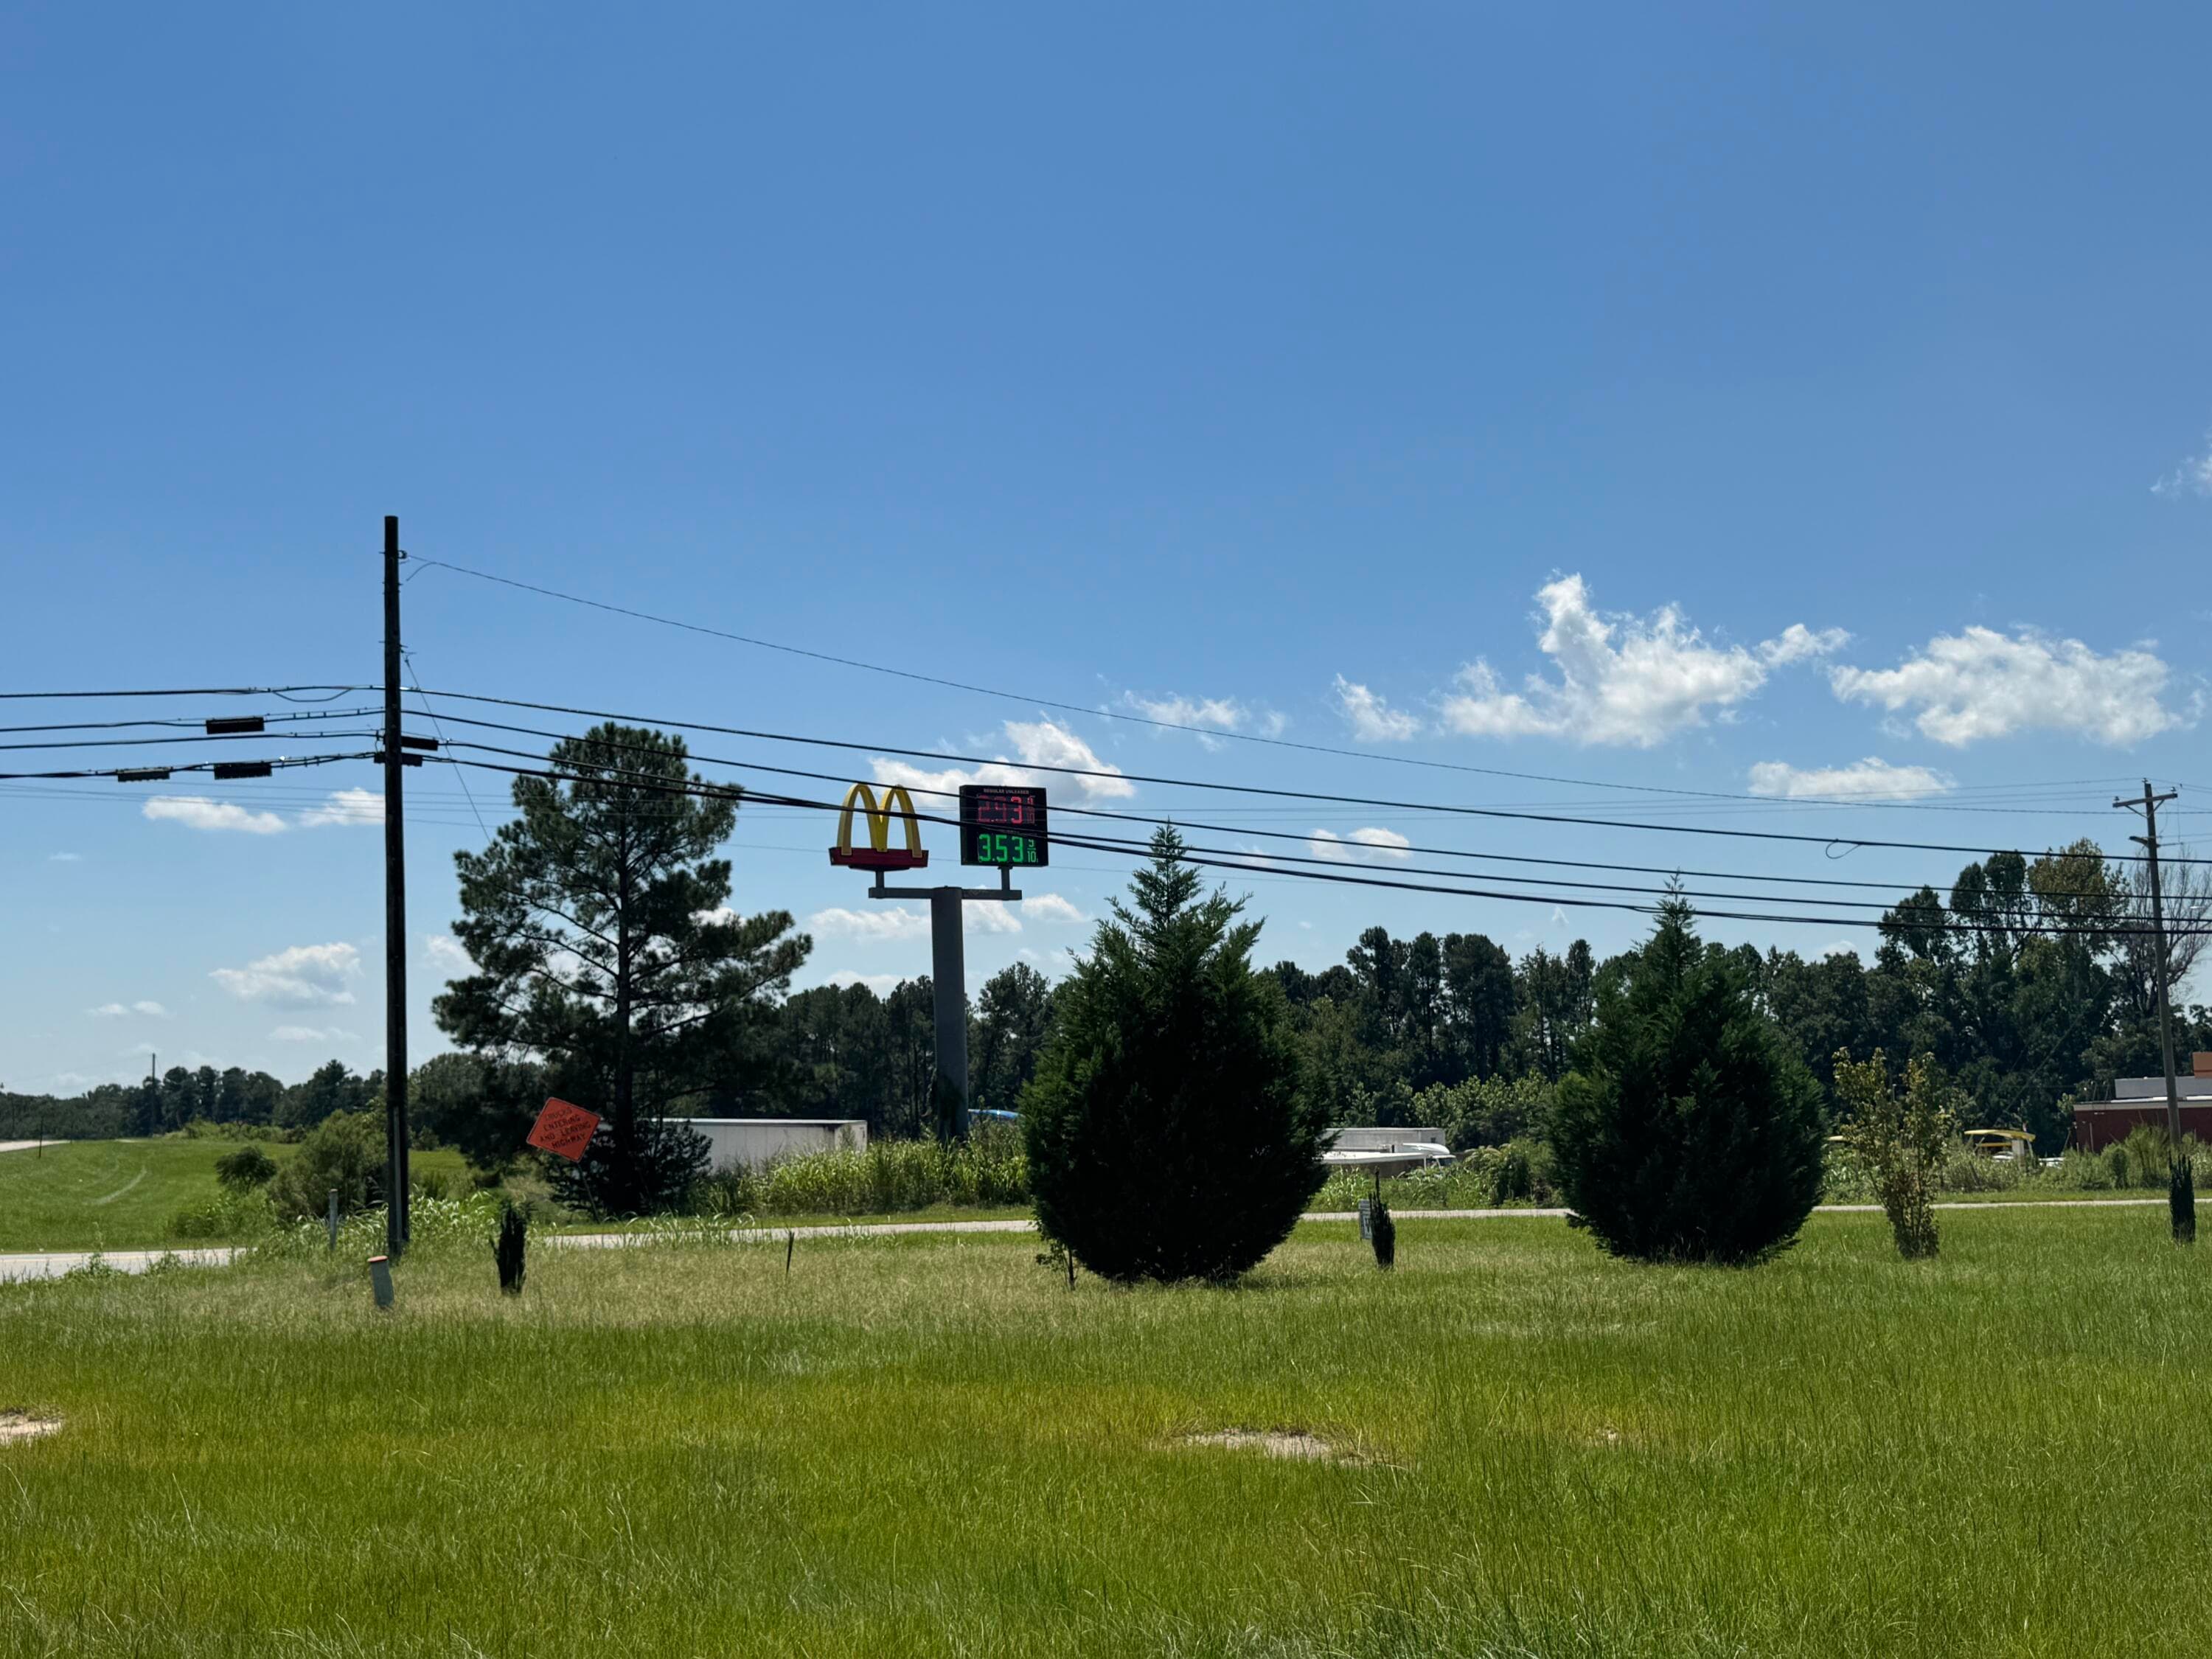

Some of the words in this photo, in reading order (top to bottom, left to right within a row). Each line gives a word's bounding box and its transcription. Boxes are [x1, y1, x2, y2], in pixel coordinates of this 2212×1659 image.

[978, 834, 1024, 863] 3.53
[539, 1133, 555, 1143] AND
[560, 1120, 591, 1136] LEAVING
[543, 1114, 581, 1132] ENTERING
[552, 1133, 585, 1150] HIGHWAY
